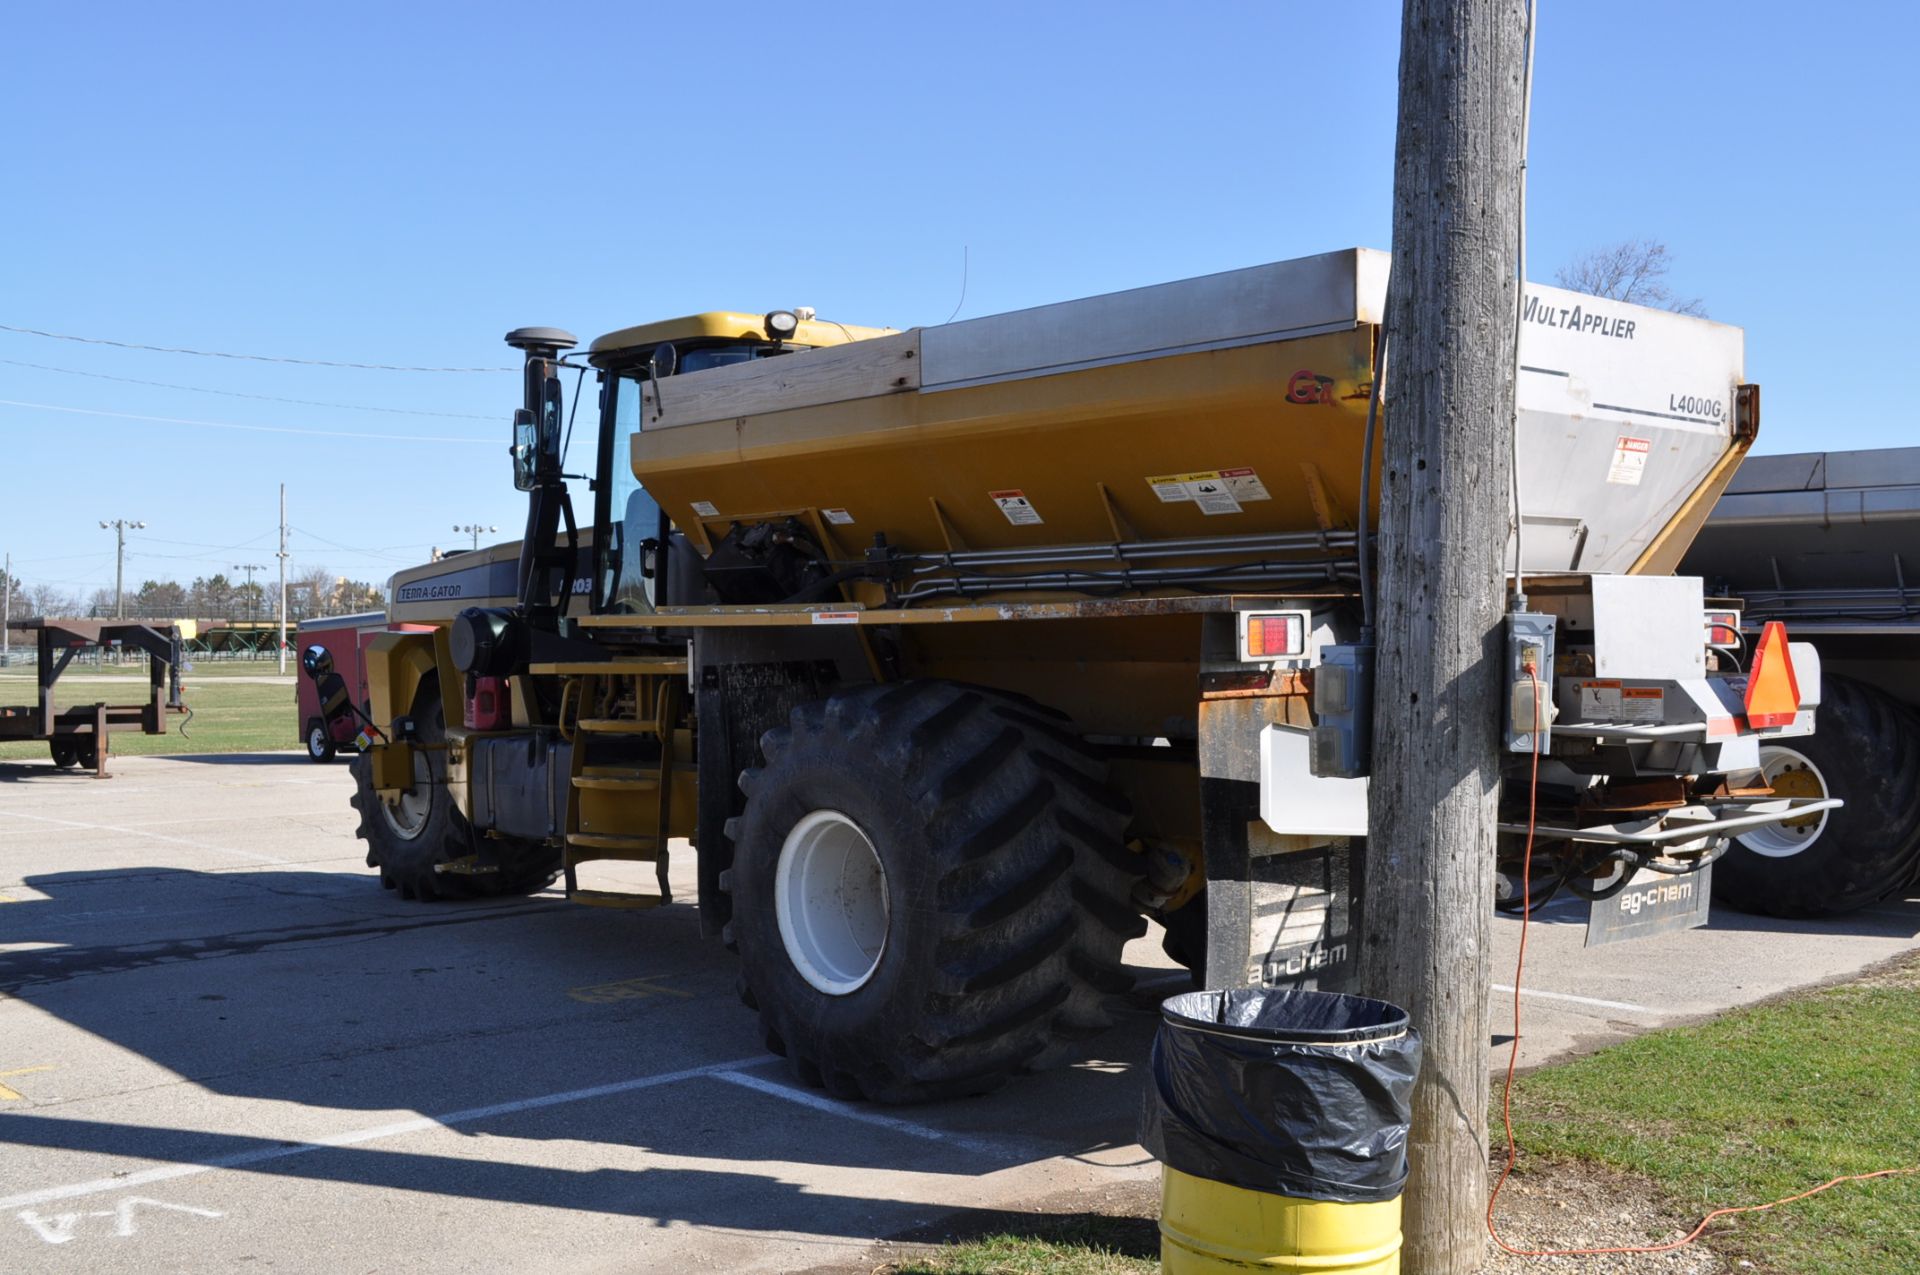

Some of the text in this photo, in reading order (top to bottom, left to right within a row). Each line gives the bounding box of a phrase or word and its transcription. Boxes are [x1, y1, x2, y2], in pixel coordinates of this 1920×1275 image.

[402, 585, 462, 600] TERRA-GATOR
[558, 578, 593, 594] 03
[1620, 882, 1693, 915] ag-chem
